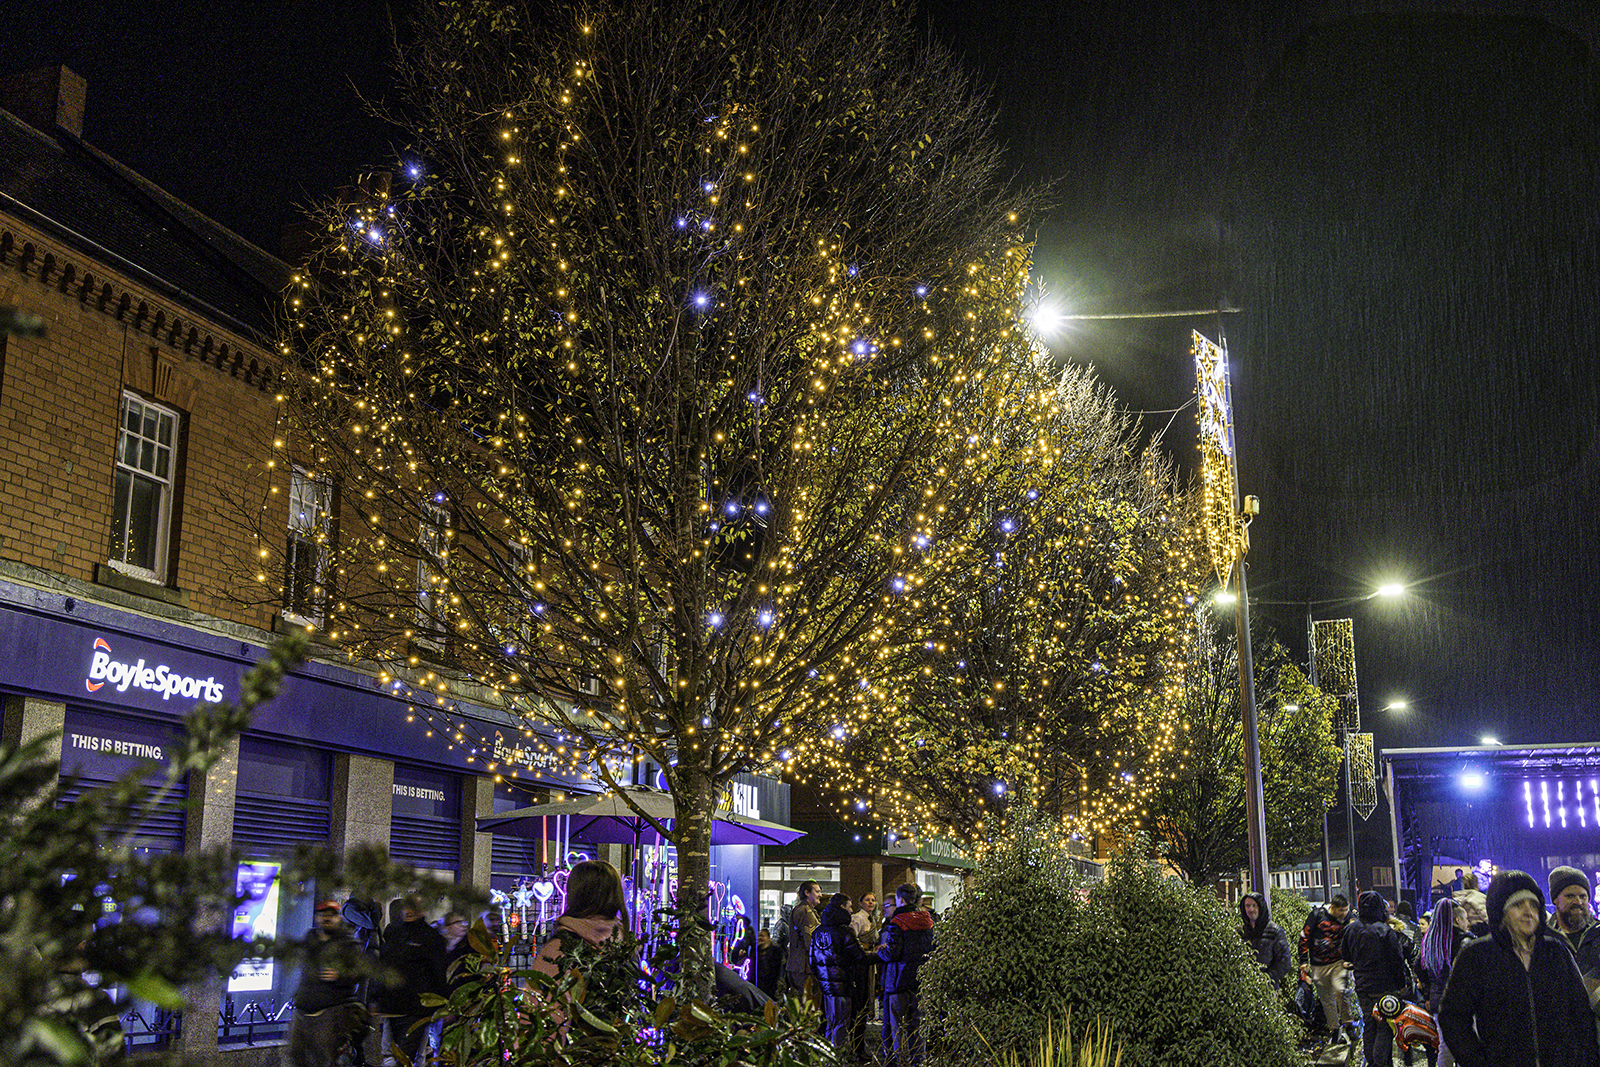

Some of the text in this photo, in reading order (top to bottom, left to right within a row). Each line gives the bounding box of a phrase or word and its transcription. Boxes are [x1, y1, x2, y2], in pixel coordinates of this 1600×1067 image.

[89, 652, 224, 704] BoyleSports
[71, 733, 164, 760] THIS IS BETTING.
[493, 739, 559, 770] BoyleSports
[392, 784, 446, 802] THIS IS BETTING.
[733, 781, 760, 820] HILL
